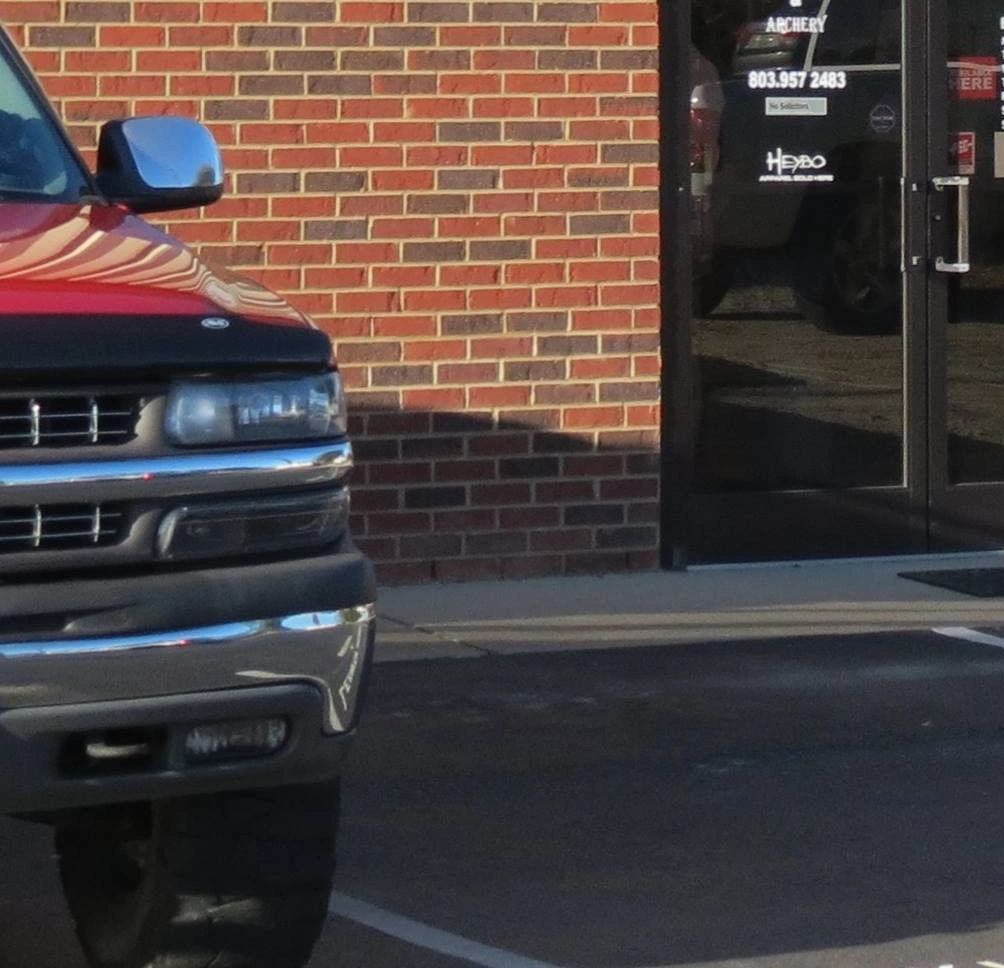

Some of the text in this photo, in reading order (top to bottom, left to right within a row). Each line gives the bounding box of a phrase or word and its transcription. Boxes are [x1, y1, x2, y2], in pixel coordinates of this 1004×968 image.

[765, 14, 828, 33] ARCHERY
[748, 71, 847, 89] 803.957 2483
[951, 77, 993, 90] ERE
